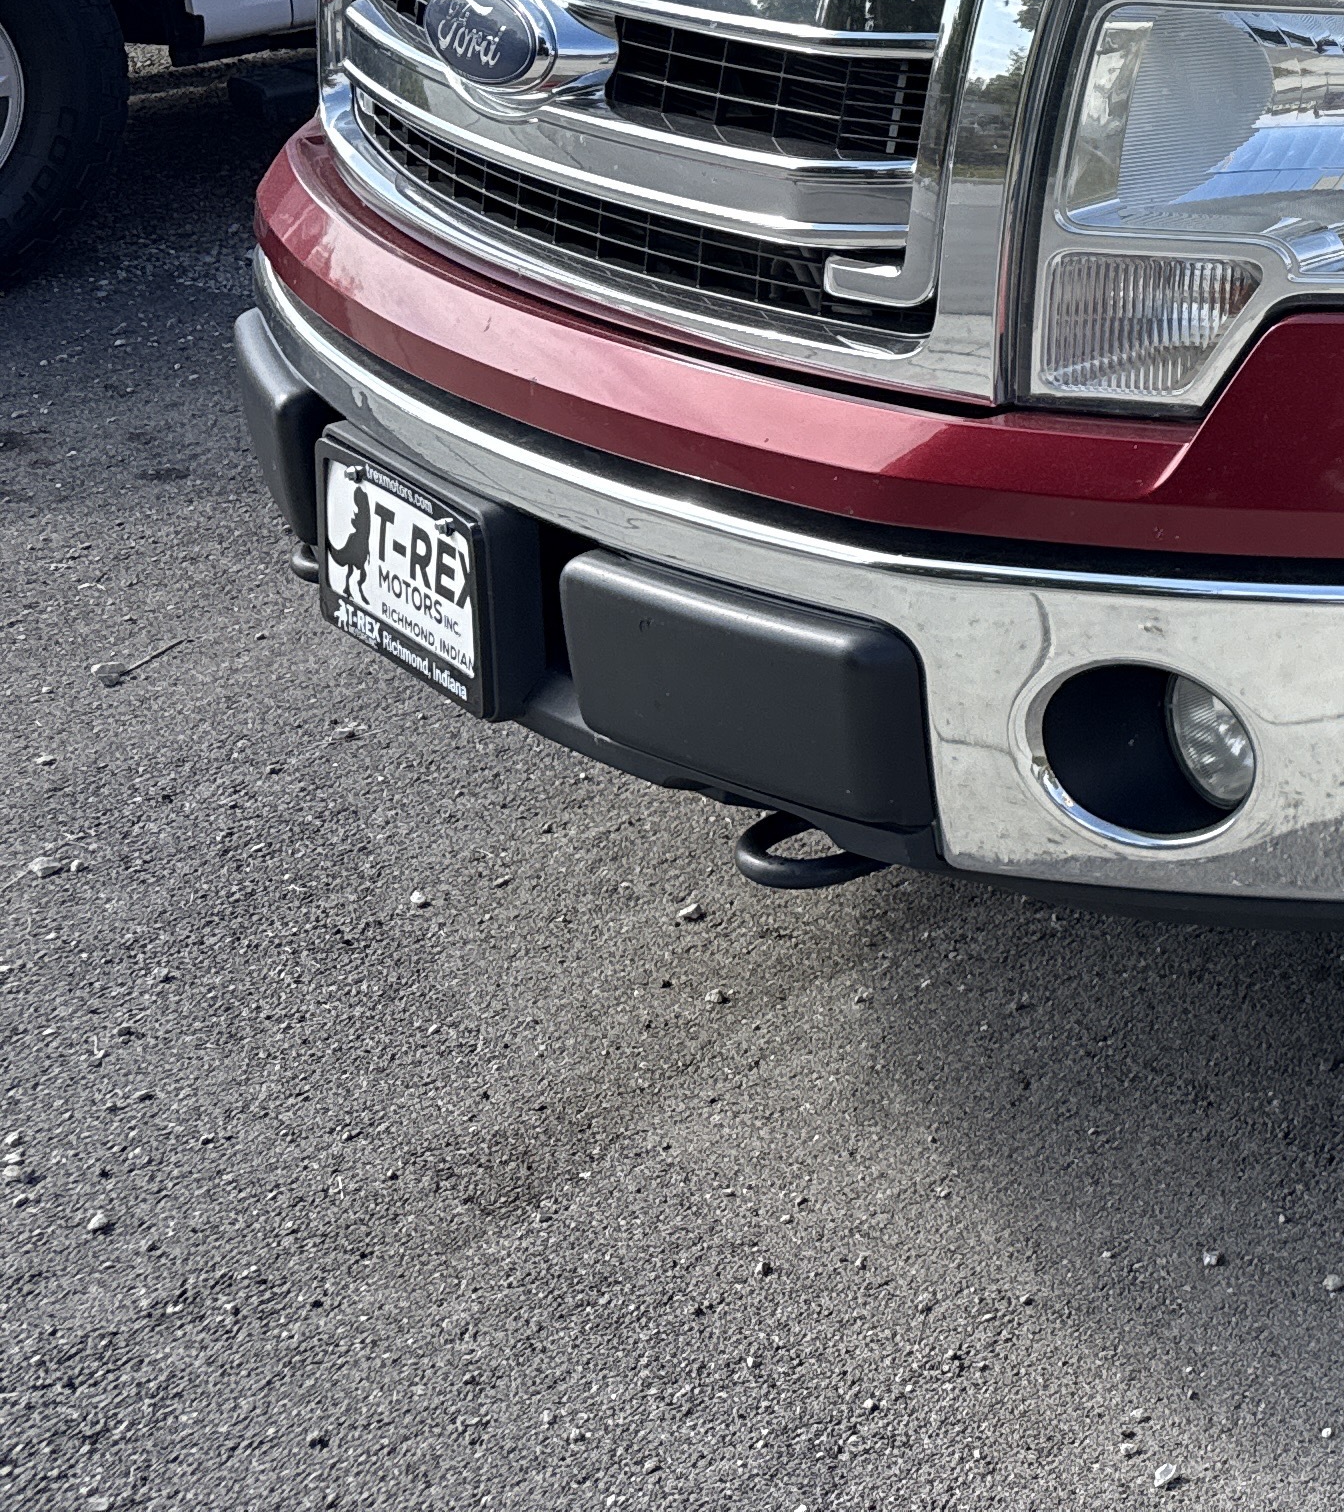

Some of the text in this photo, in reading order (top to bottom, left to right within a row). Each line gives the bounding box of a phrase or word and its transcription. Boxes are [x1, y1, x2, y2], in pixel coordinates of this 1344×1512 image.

[366, 463, 433, 515] trexmotors.com
[374, 501, 469, 609] T-REX
[379, 565, 442, 624] MOTORS
[346, 604, 381, 643] T-REX
[383, 631, 431, 679] Richmond,
[433, 662, 467, 701] Indiana
